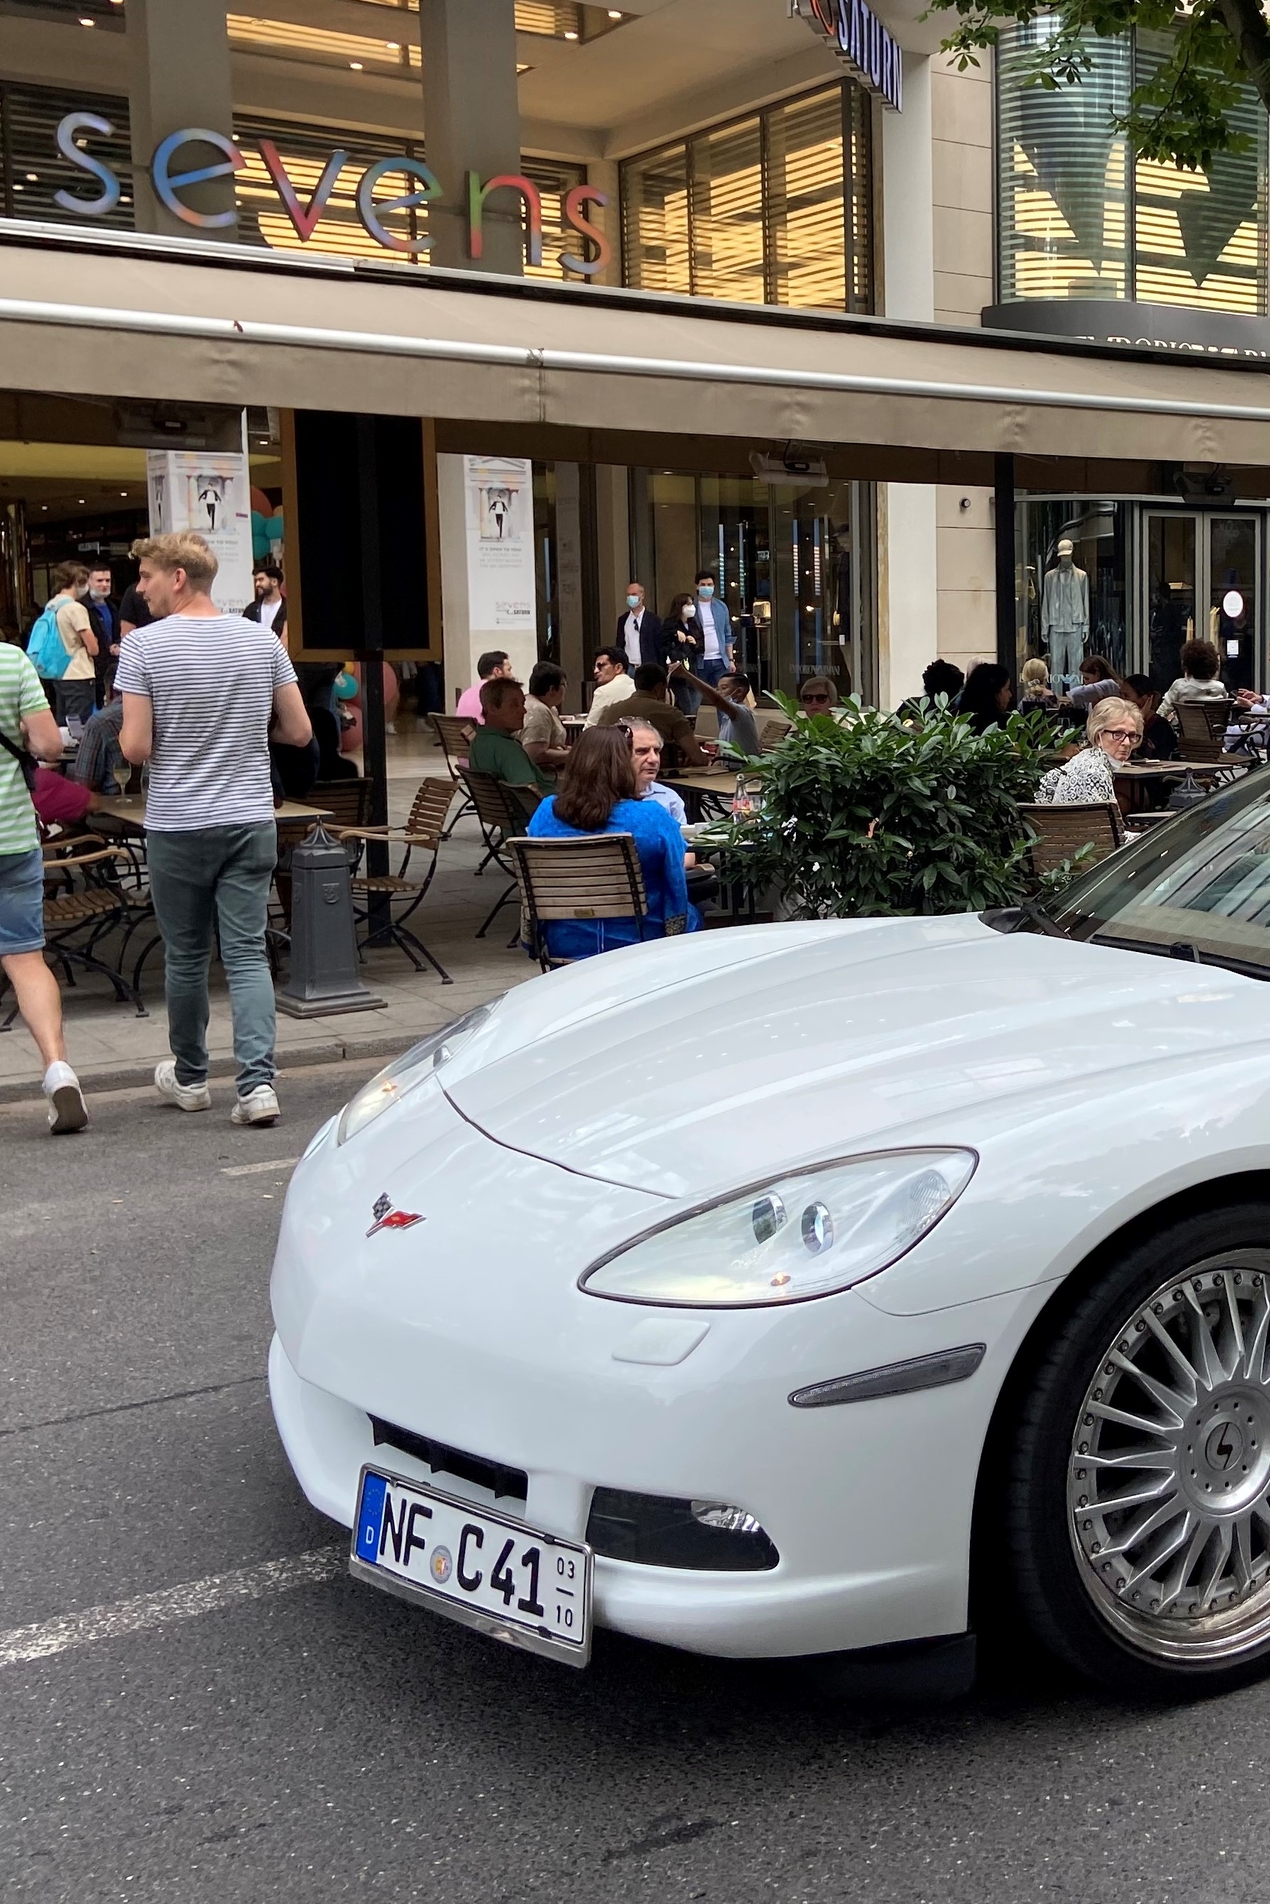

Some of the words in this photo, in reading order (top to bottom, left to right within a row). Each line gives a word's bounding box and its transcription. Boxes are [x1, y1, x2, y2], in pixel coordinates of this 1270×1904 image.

[838, 0, 902, 114] SATURN
[53, 111, 611, 275] sevens
[365, 1525, 375, 1545] D
[379, 1492, 433, 1567] NF
[556, 1556, 576, 1579] 03
[556, 1604, 574, 1628] 10
